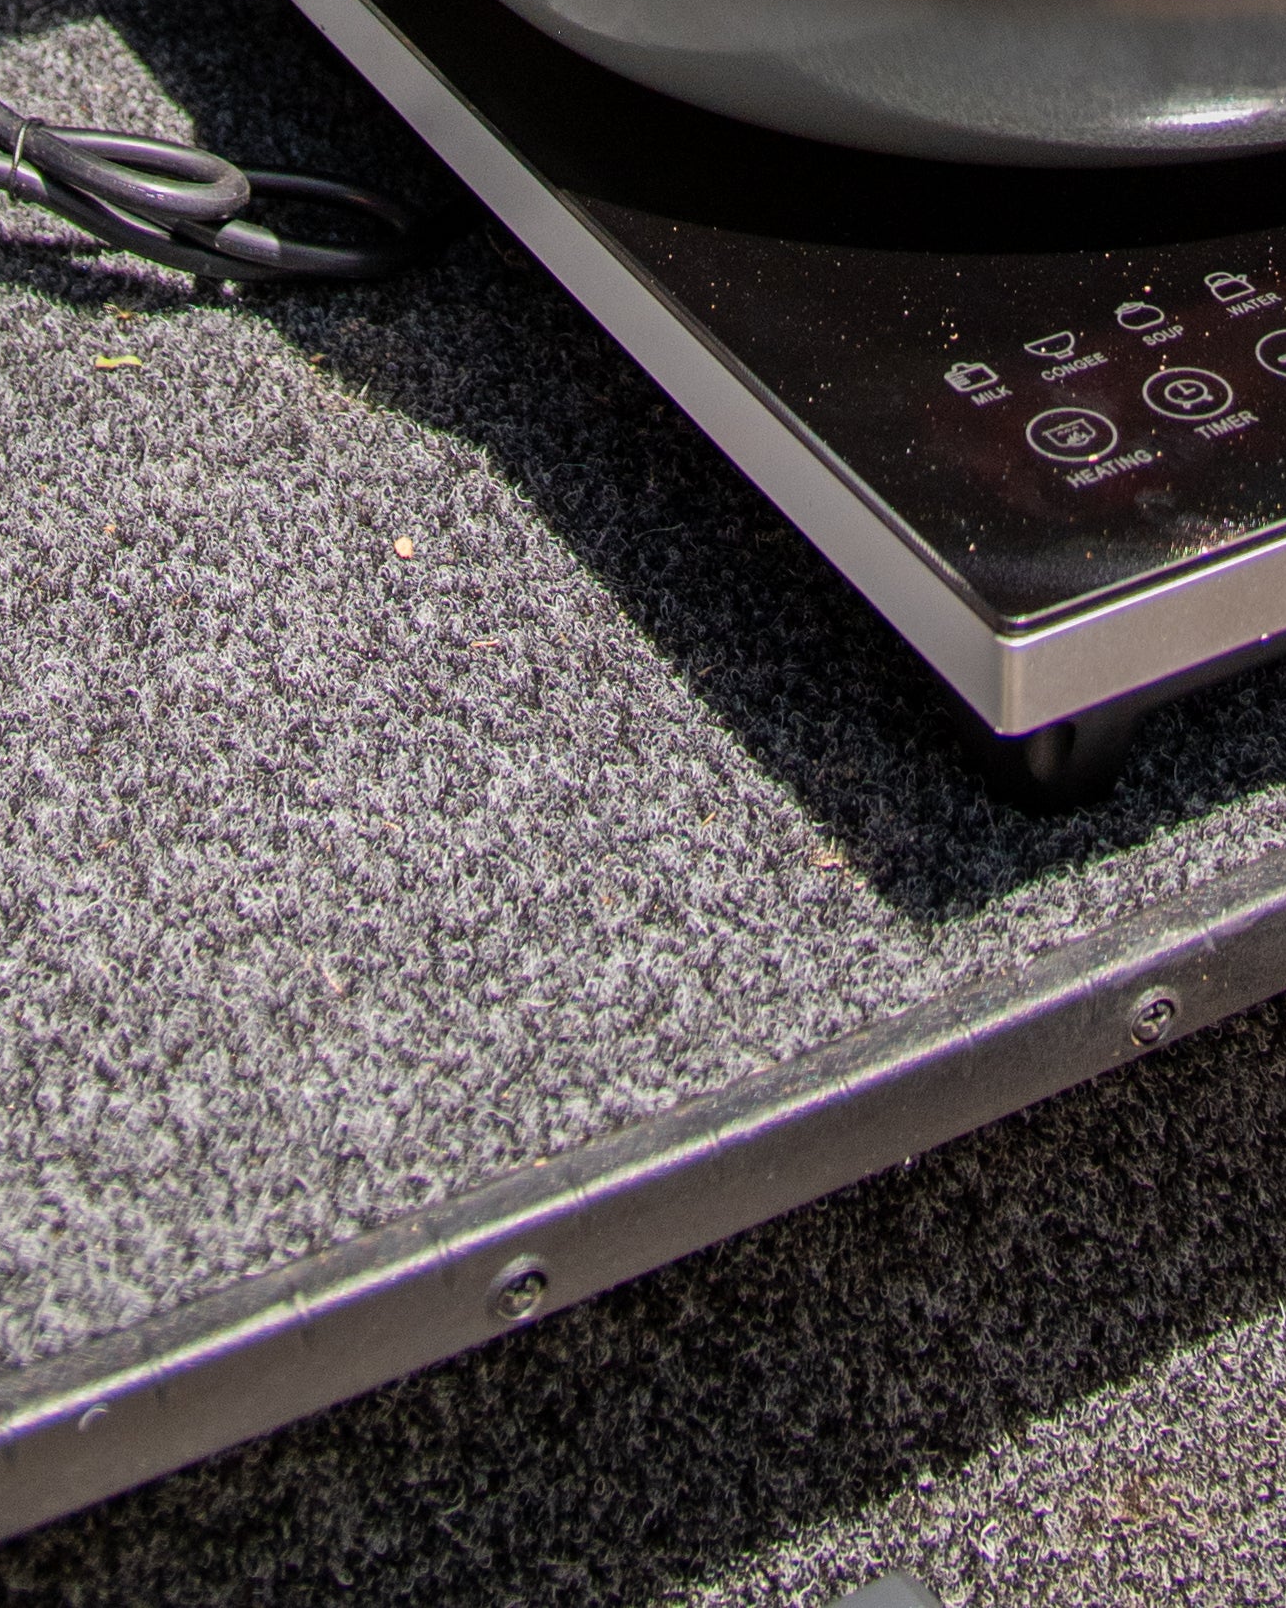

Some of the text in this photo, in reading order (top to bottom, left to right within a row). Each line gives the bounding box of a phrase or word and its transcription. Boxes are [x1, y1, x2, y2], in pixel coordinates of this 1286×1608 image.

[1226, 291, 1283, 319] WATER
[1142, 324, 1186, 347] SOUP
[1040, 350, 1109, 382] CONGEE
[970, 385, 1013, 407] MILK
[1193, 409, 1260, 442] TIMER
[1066, 448, 1154, 489] HEATING
